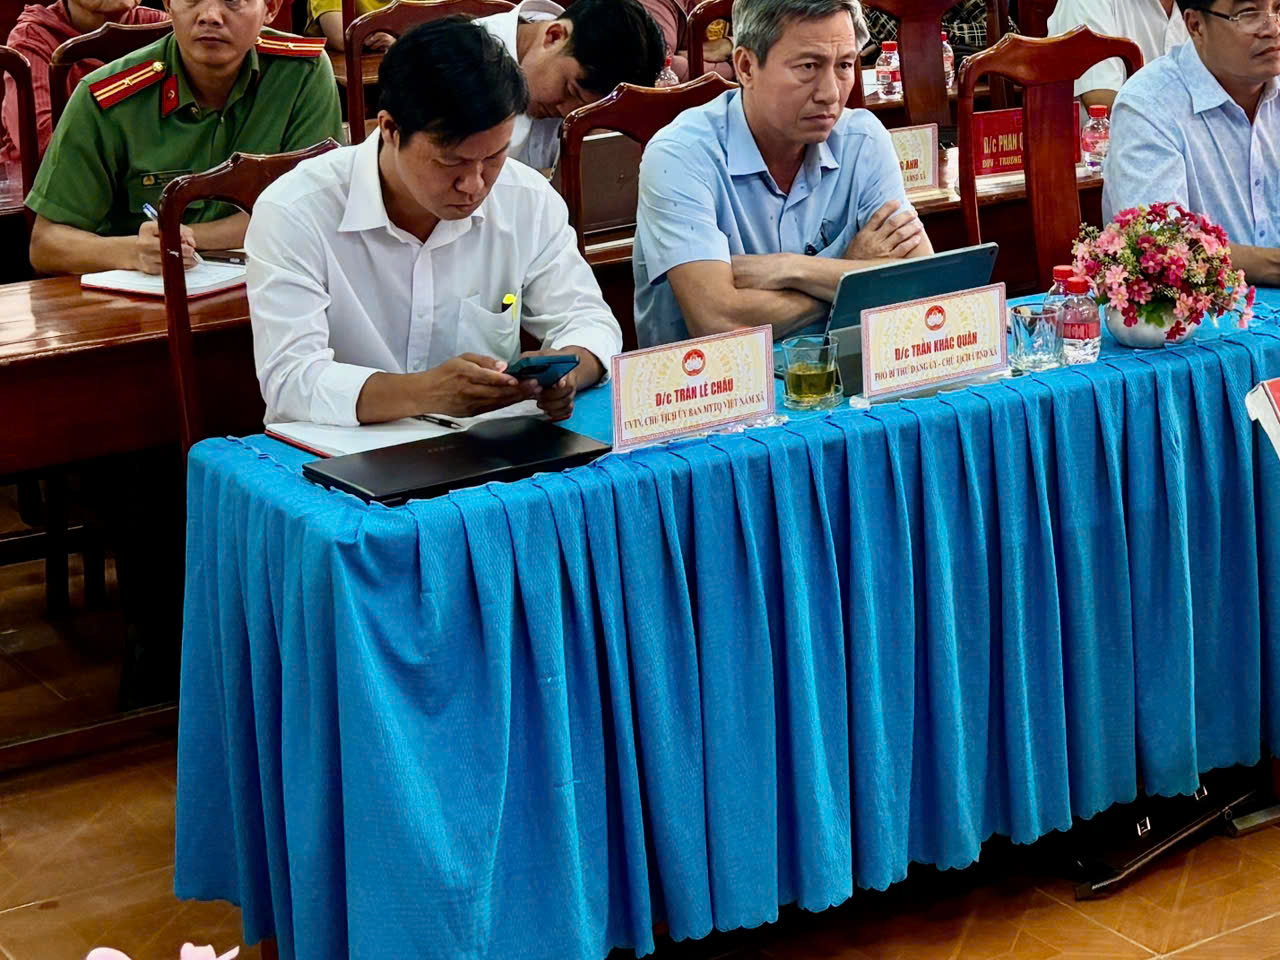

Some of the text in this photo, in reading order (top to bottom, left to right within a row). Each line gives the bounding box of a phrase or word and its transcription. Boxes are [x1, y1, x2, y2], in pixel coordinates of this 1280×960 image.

[895, 330, 978, 361] Đ/c TRẦN KHẮC QUÂN
[655, 377, 734, 407] Đ/c TRẦN LÊ CHÂU
